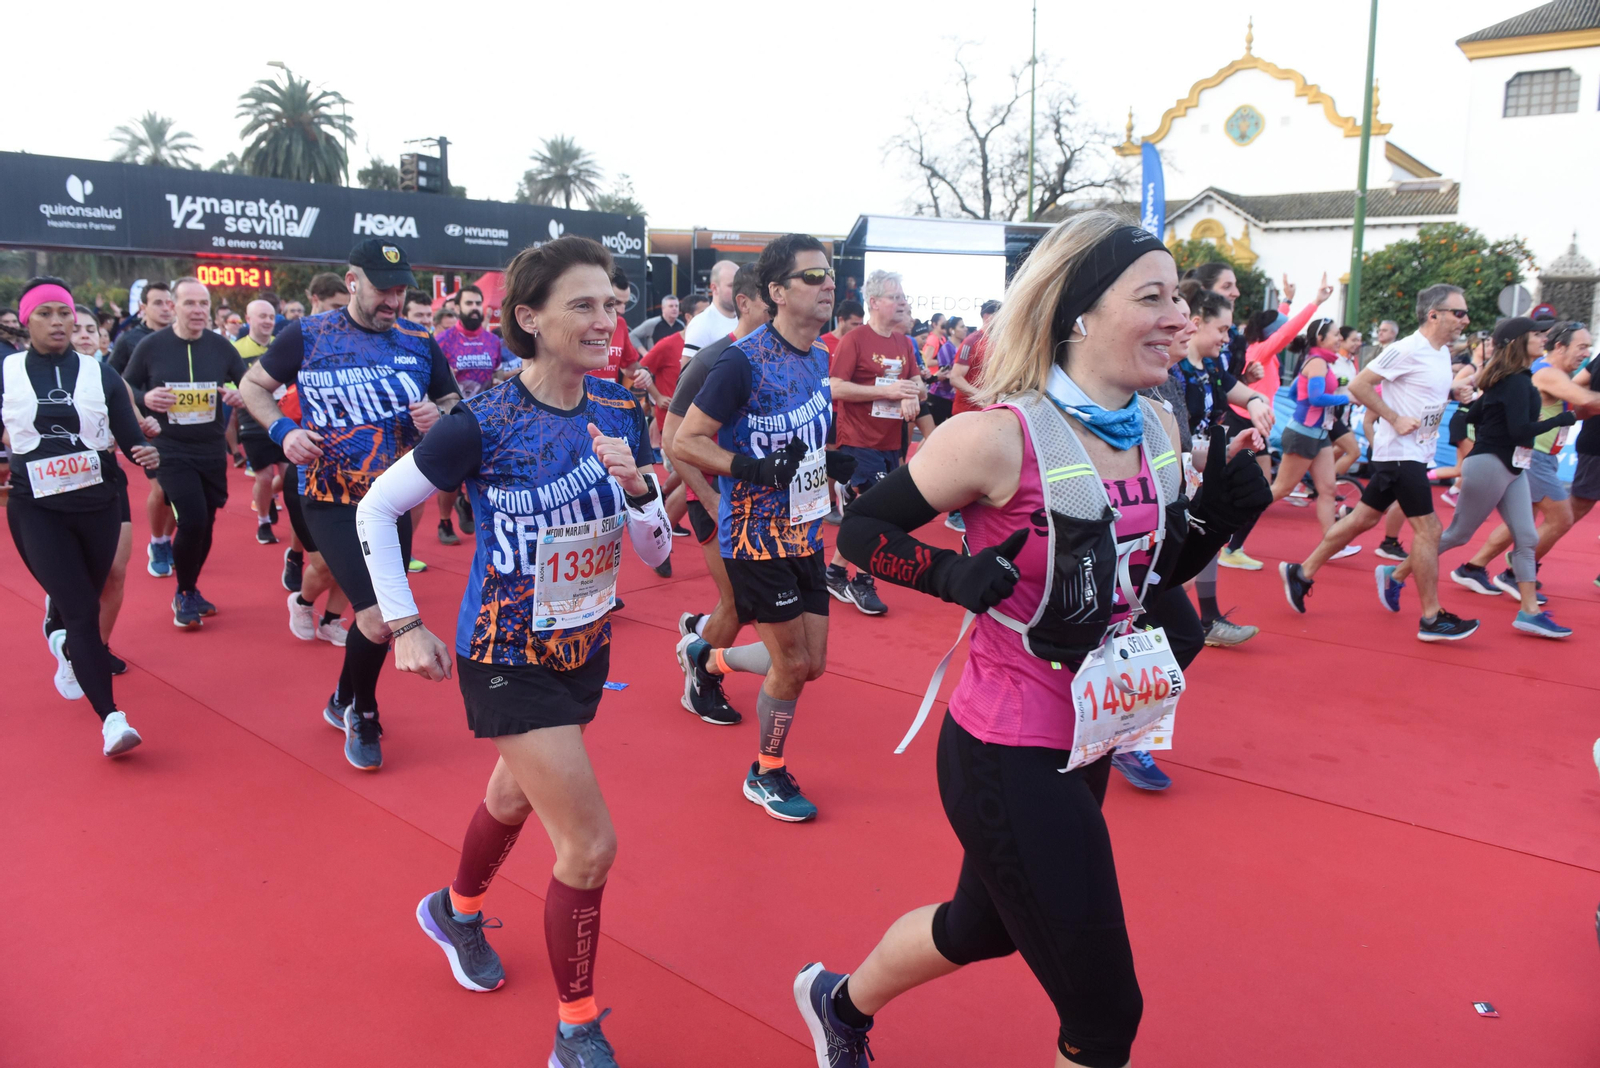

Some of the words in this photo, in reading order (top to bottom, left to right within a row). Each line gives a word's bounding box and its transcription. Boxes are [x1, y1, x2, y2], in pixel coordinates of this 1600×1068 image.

[196, 196, 299, 221] maratón
[47, 219, 88, 229] Healthcare
[89, 221, 116, 231] Partner
[225, 216, 301, 237] sevilla
[353, 212, 419, 239] HOKA
[464, 226, 509, 239] HYUNDAI
[212, 236, 225, 247] 28
[227, 238, 257, 249] enero
[258, 239, 284, 250] 2024
[197, 265, 271, 287] 00:07:21
[394, 356, 417, 364] HOKA
[298, 370, 333, 387] MEDIO
[303, 371, 421, 427] SEVILLA
[748, 414, 786, 432] MEDIO
[788, 390, 827, 429] MARATÓN
[35, 455, 90, 480] 14202
[487, 485, 534, 515] MEDIO
[537, 455, 606, 511] MARATÓN
[565, 523, 590, 537] MARATÓN
[602, 513, 626, 533] SEVILL
[546, 541, 615, 583] 13322
[1127, 634, 1154, 654] SEVILLA
[1083, 665, 1169, 721] 14046
